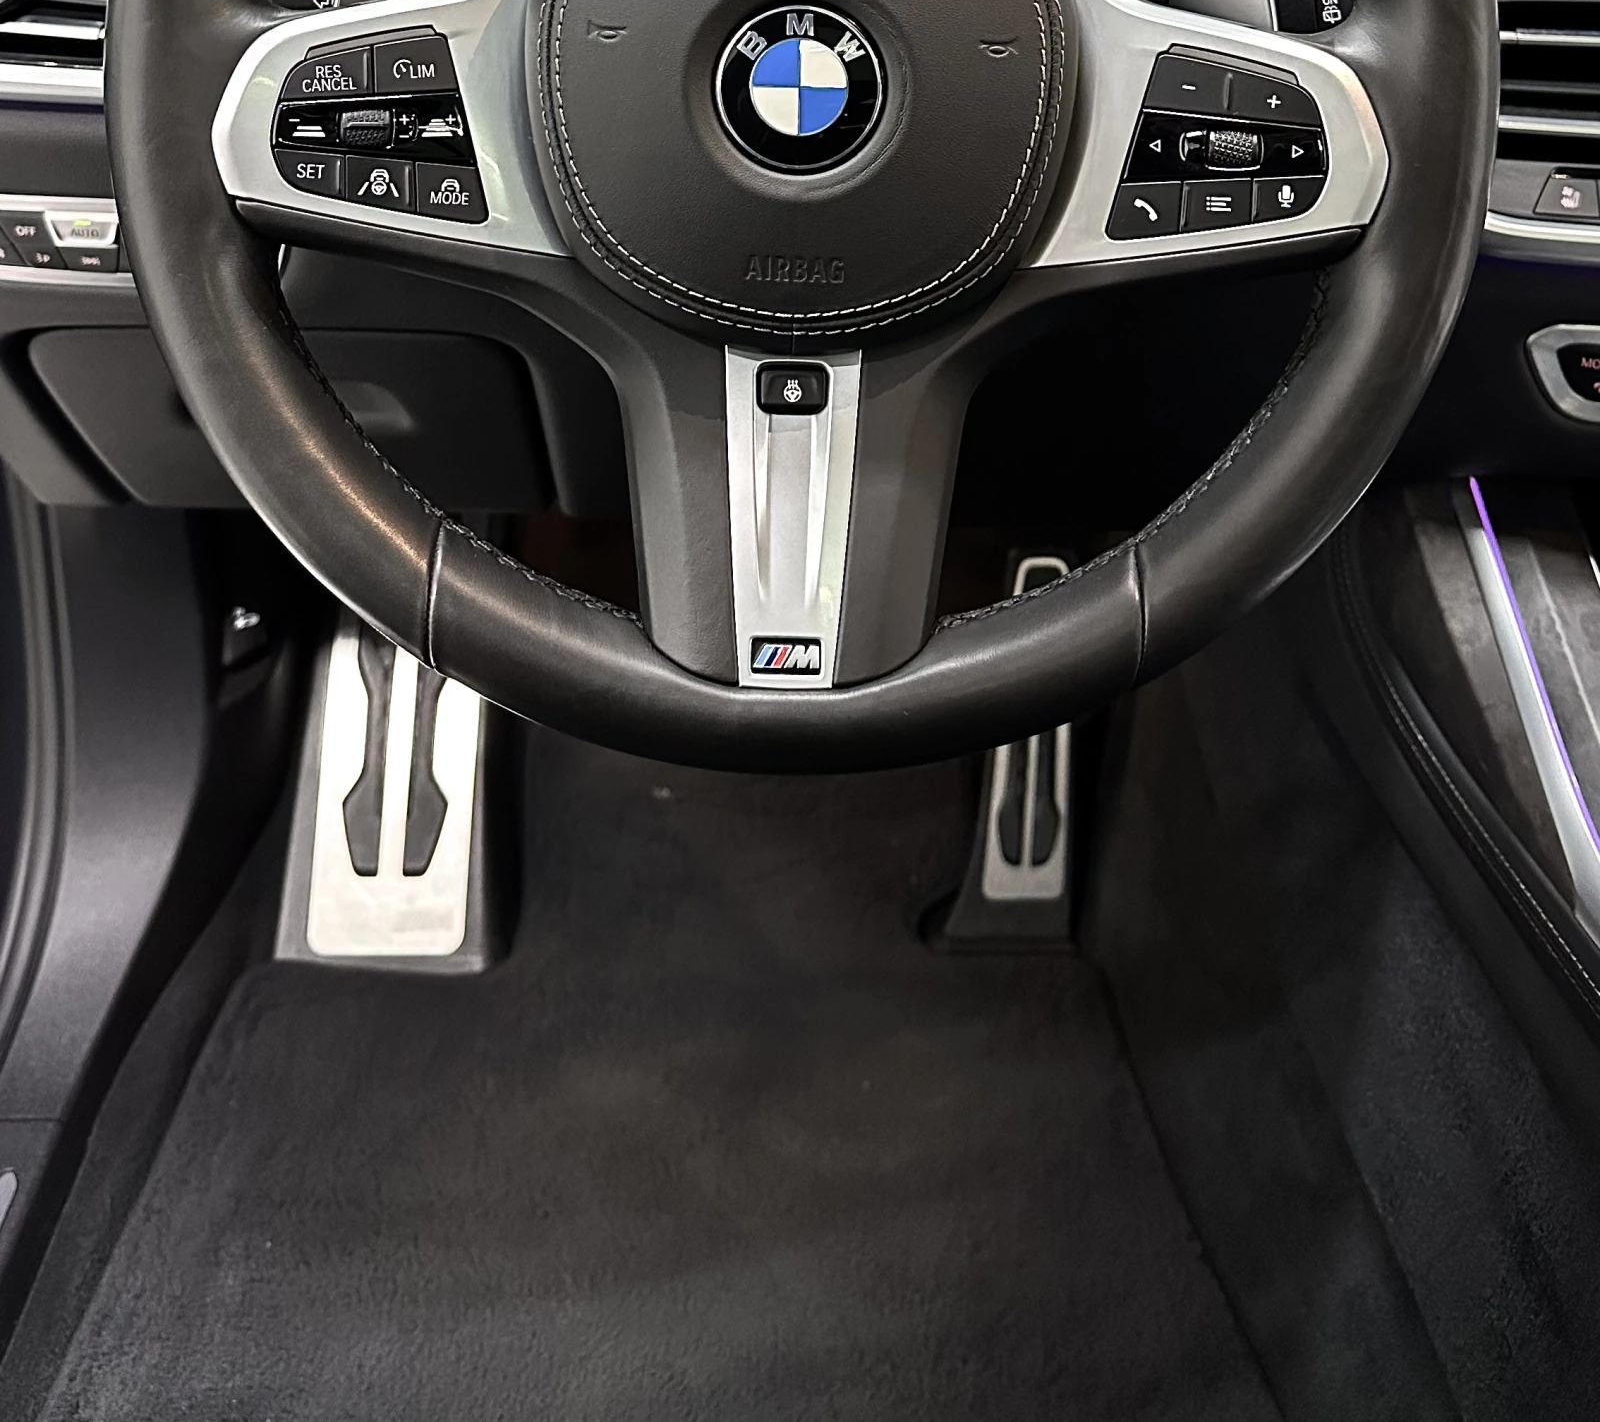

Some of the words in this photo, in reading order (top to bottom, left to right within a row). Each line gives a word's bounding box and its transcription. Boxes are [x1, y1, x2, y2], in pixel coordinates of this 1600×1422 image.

[735, 12, 867, 63] BMW
[315, 65, 341, 79] RES
[409, 63, 435, 79] LIM
[302, 76, 357, 93] CANCEL
[296, 164, 325, 180] SET
[430, 190, 469, 206] MODE
[15, 225, 36, 236] OFF
[71, 229, 100, 238] AUTO
[744, 255, 845, 284] AIRBAG
